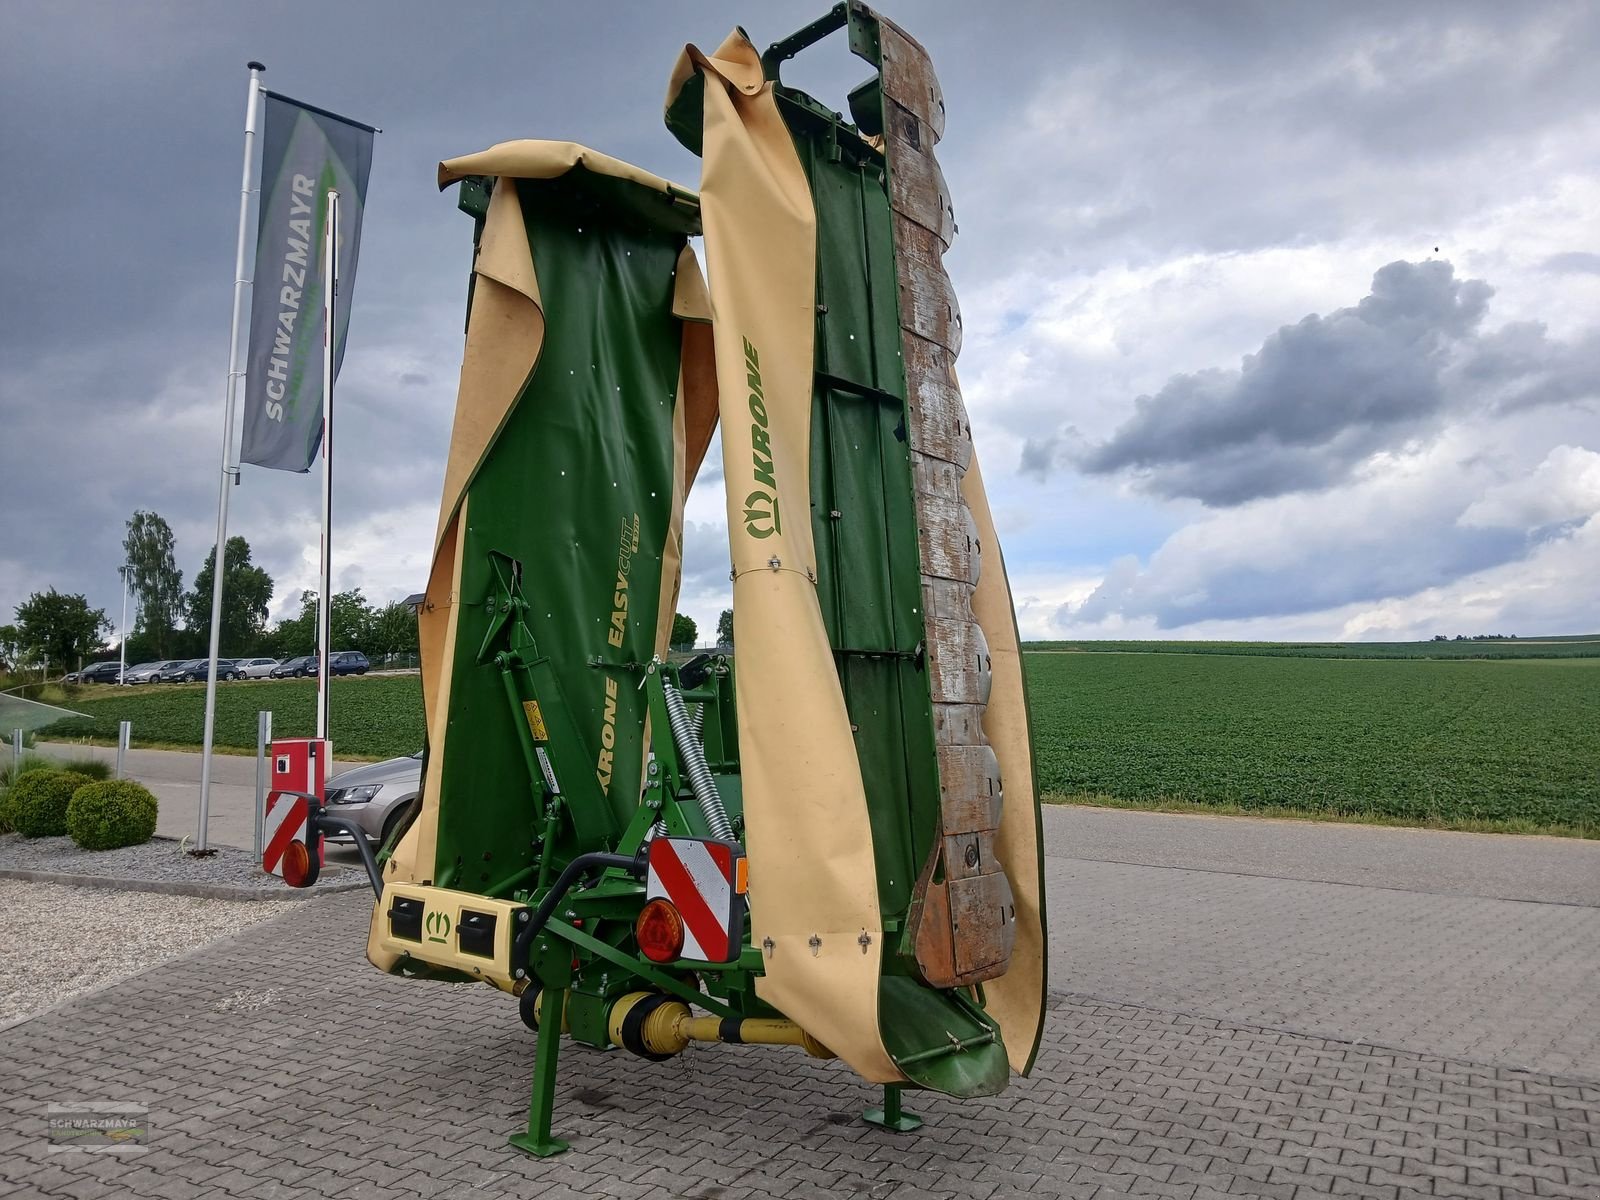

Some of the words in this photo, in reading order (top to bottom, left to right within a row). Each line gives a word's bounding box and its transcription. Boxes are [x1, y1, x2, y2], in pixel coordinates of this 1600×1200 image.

[265, 173, 316, 423] SCHWARZMAYR
[742, 334, 777, 491] KRONE
[596, 676, 618, 797] KRONE
[607, 516, 634, 649] EASYCUT
